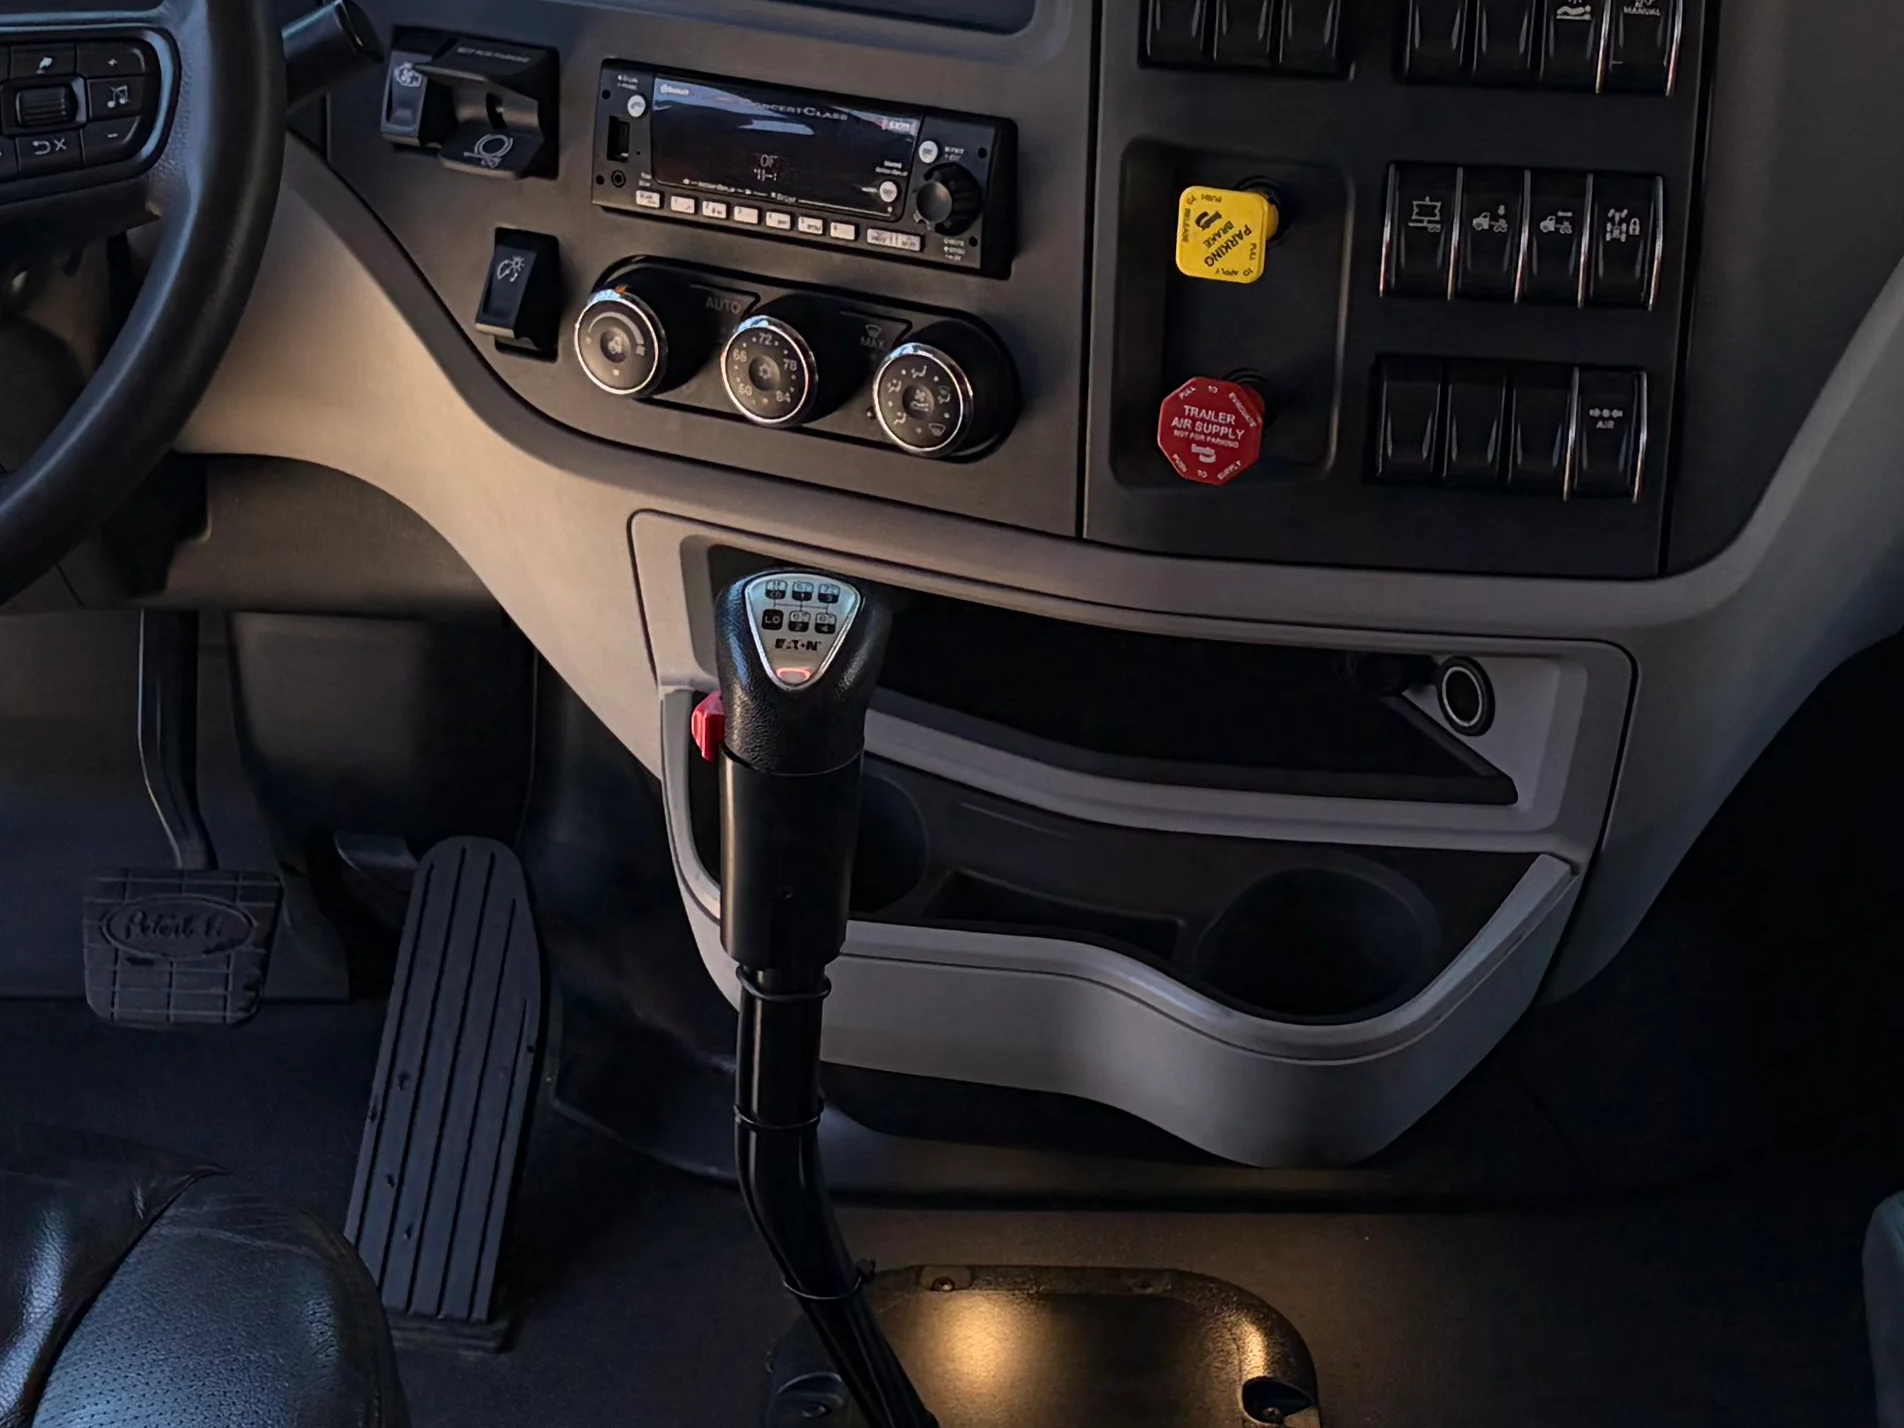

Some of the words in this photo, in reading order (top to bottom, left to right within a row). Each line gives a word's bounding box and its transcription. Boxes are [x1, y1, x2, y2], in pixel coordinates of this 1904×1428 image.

[1203, 220, 1234, 249] BRAKE
[1204, 224, 1252, 267] PARKING
[706, 297, 741, 315] AUTO
[758, 332, 773, 347] 72
[860, 335, 885, 350] MAX
[783, 359, 797, 371] 78
[1184, 405, 1236, 425] TRAILER
[1171, 417, 1192, 429] AIR
[1195, 421, 1245, 440] SUPPLY
[1596, 420, 1615, 429] AIR
[1173, 429, 1189, 438] NOT
[765, 615, 781, 624] LO
